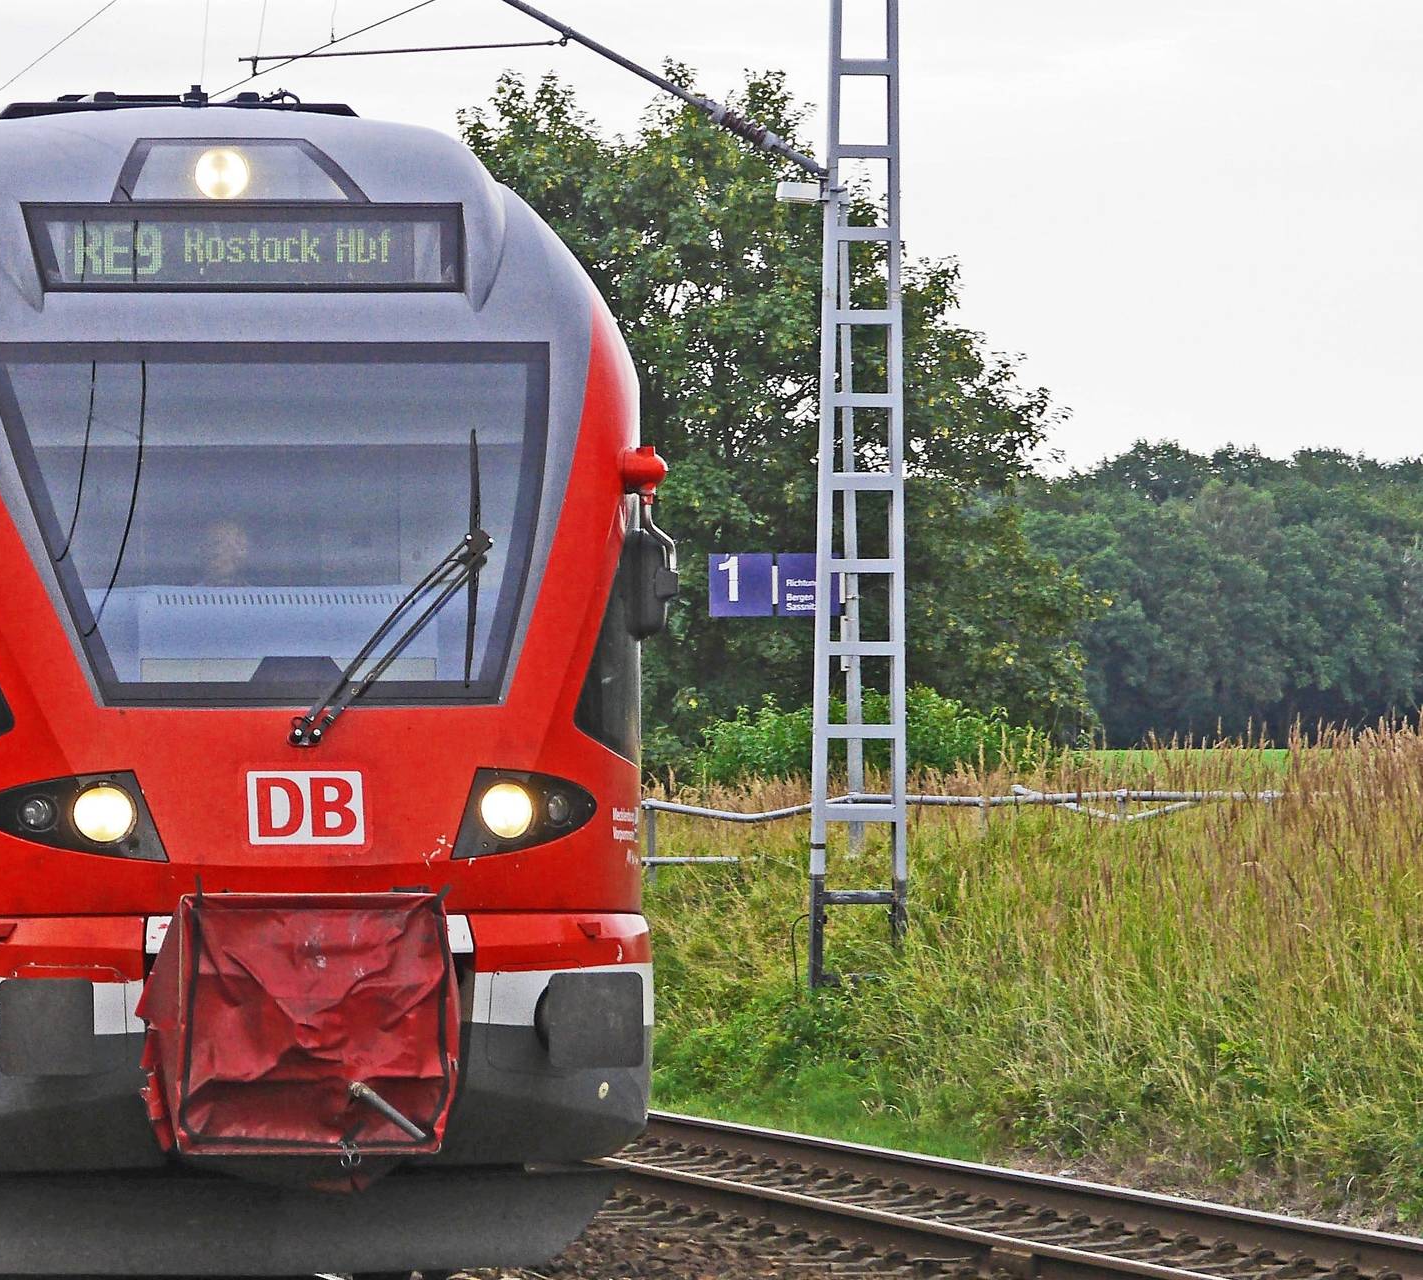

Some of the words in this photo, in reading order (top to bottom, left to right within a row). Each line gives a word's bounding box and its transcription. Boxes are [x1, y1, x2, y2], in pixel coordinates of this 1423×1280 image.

[74, 225, 162, 275] RE9
[184, 228, 321, 263] Rostock
[718, 556, 738, 601] 1
[255, 777, 357, 837] DB
